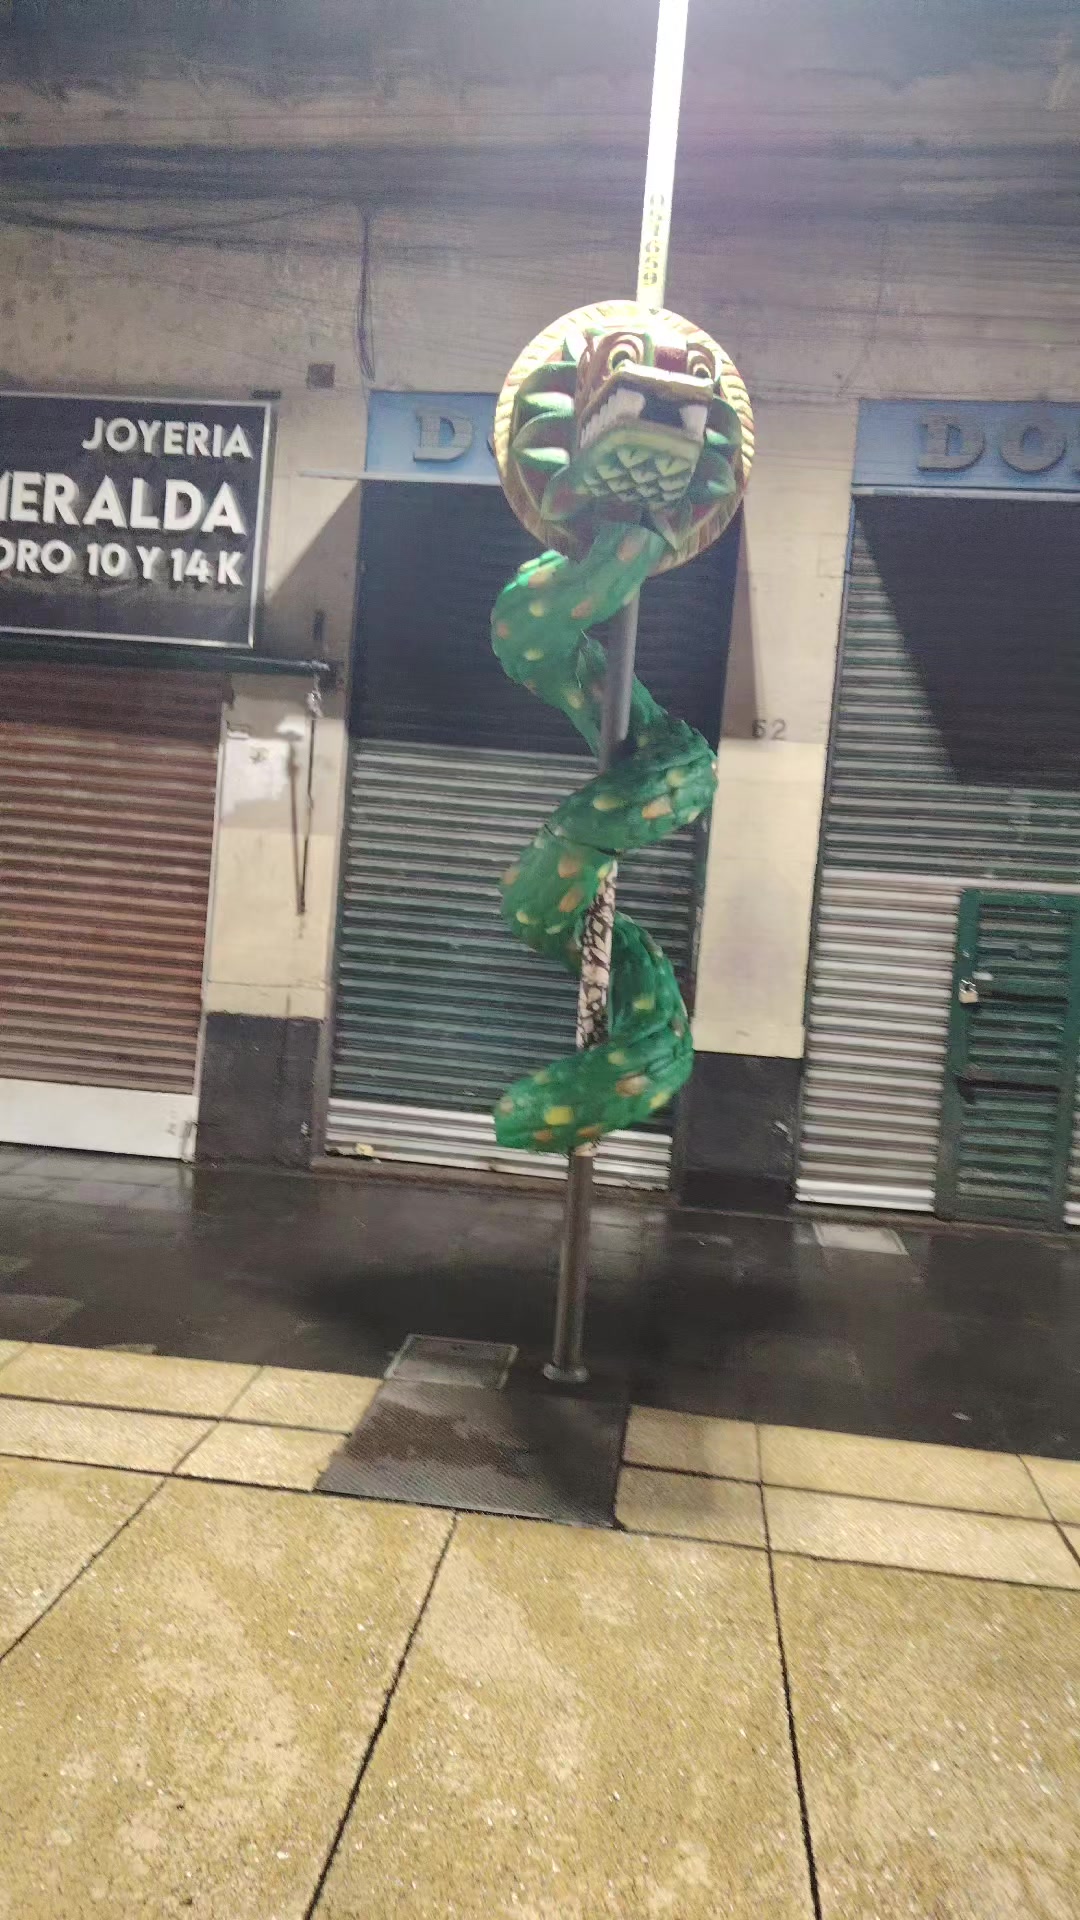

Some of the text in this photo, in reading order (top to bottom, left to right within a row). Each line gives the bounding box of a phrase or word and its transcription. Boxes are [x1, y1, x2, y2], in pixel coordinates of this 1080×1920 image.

[82, 417, 253, 459] JOYERIA
[413, 406, 495, 463] D
[916, 412, 1080, 474] DO
[87, 542, 131, 577] 10
[136, 545, 166, 580] Y
